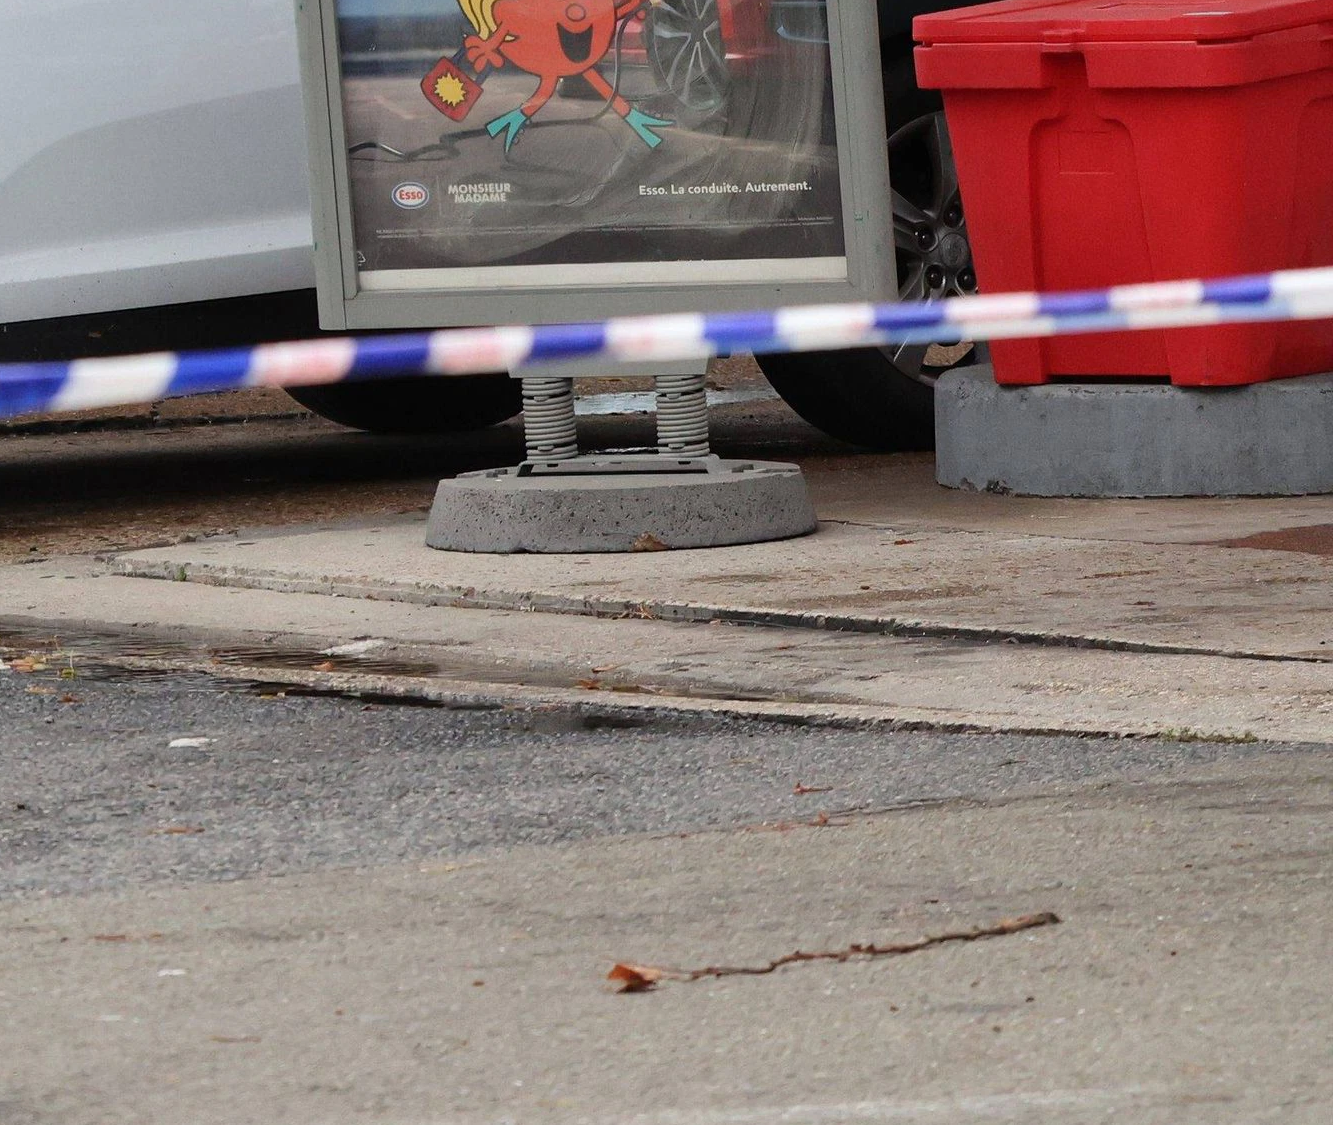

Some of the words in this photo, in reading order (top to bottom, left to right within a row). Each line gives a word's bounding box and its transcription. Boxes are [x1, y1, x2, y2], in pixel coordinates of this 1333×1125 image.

[398, 189, 423, 200] Esso
[447, 182, 512, 195] MONSIEUR
[639, 184, 668, 196] Esso.
[671, 184, 685, 195] La
[688, 182, 742, 195] conduite.
[745, 181, 813, 194] Autrement.
[454, 193, 507, 204] MADAME
